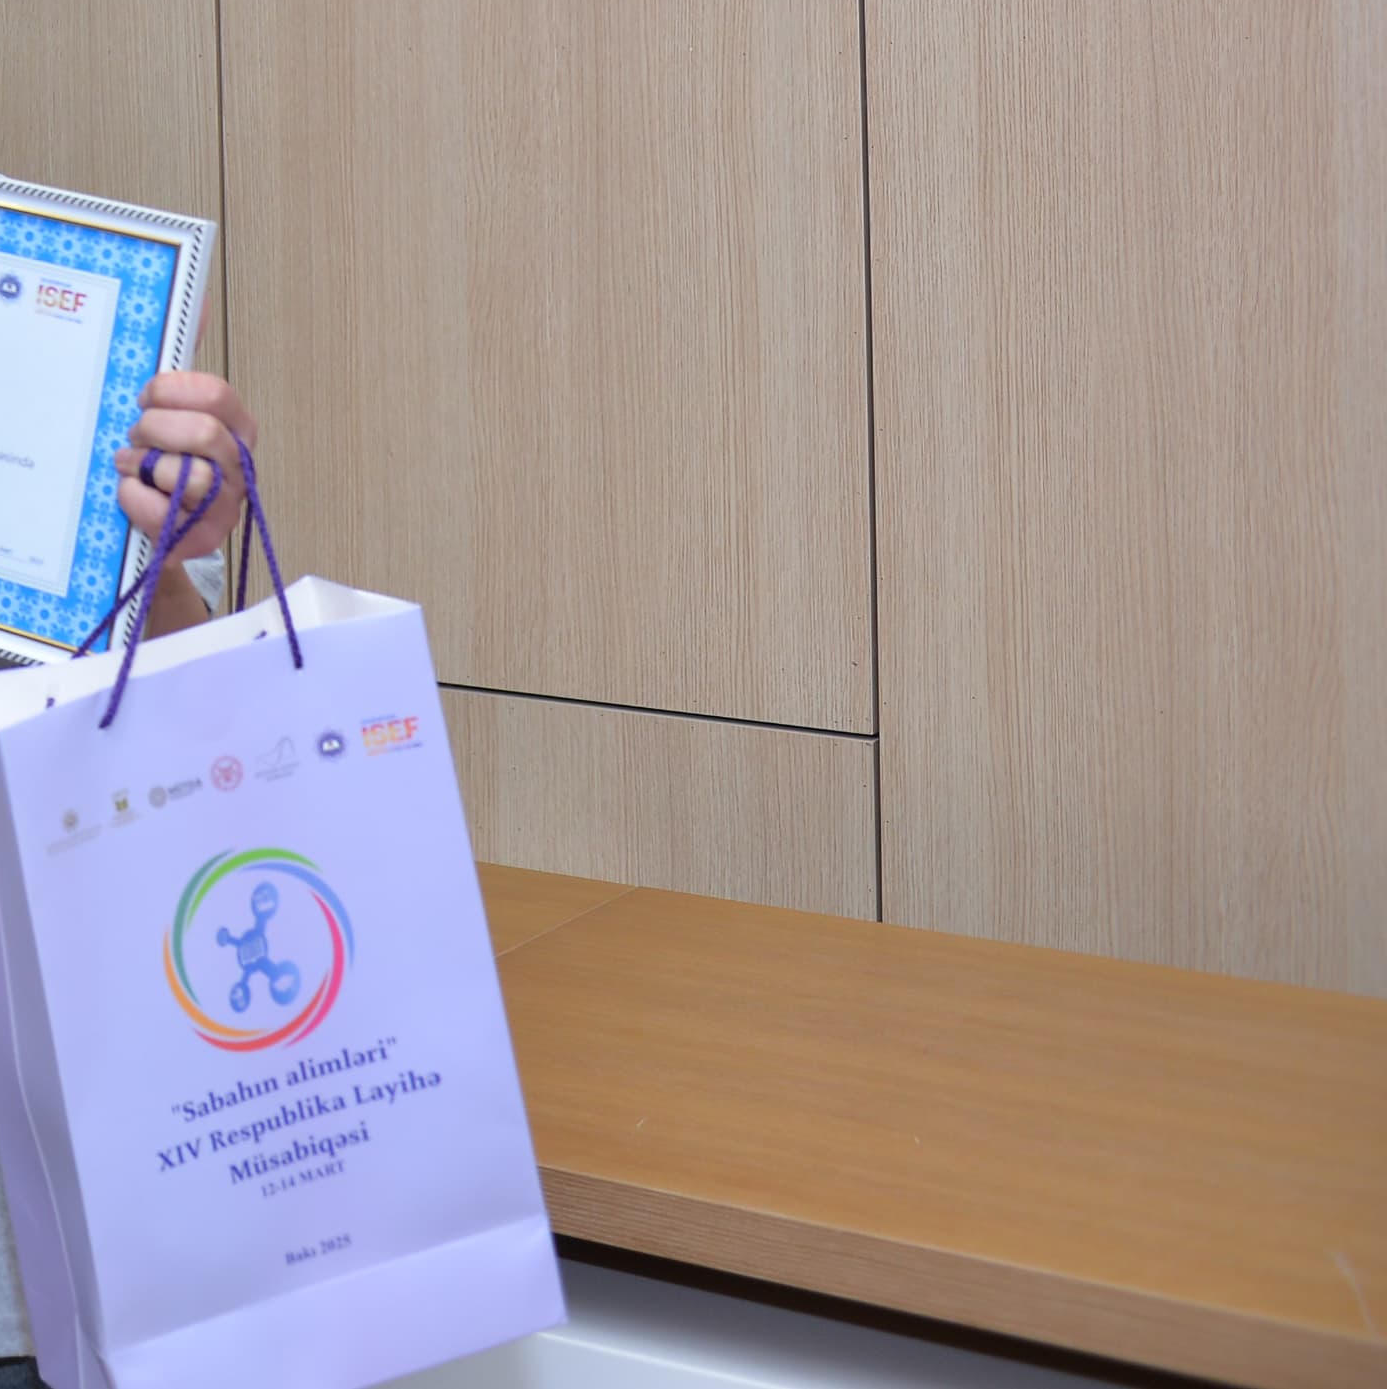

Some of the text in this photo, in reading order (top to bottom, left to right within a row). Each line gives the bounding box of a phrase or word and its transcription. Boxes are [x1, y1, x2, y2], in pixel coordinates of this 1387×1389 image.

[36, 284, 87, 312] ISEF
[362, 716, 418, 747] ISEF
[171, 1037, 396, 1123] "Sabahın alimləri"
[157, 1069, 441, 1173] XIV Respublika Layihə
[229, 1121, 369, 1184] Müsabiqəsi
[261, 1160, 345, 1199] 12-14 MART
[319, 1233, 352, 1253] 2025
